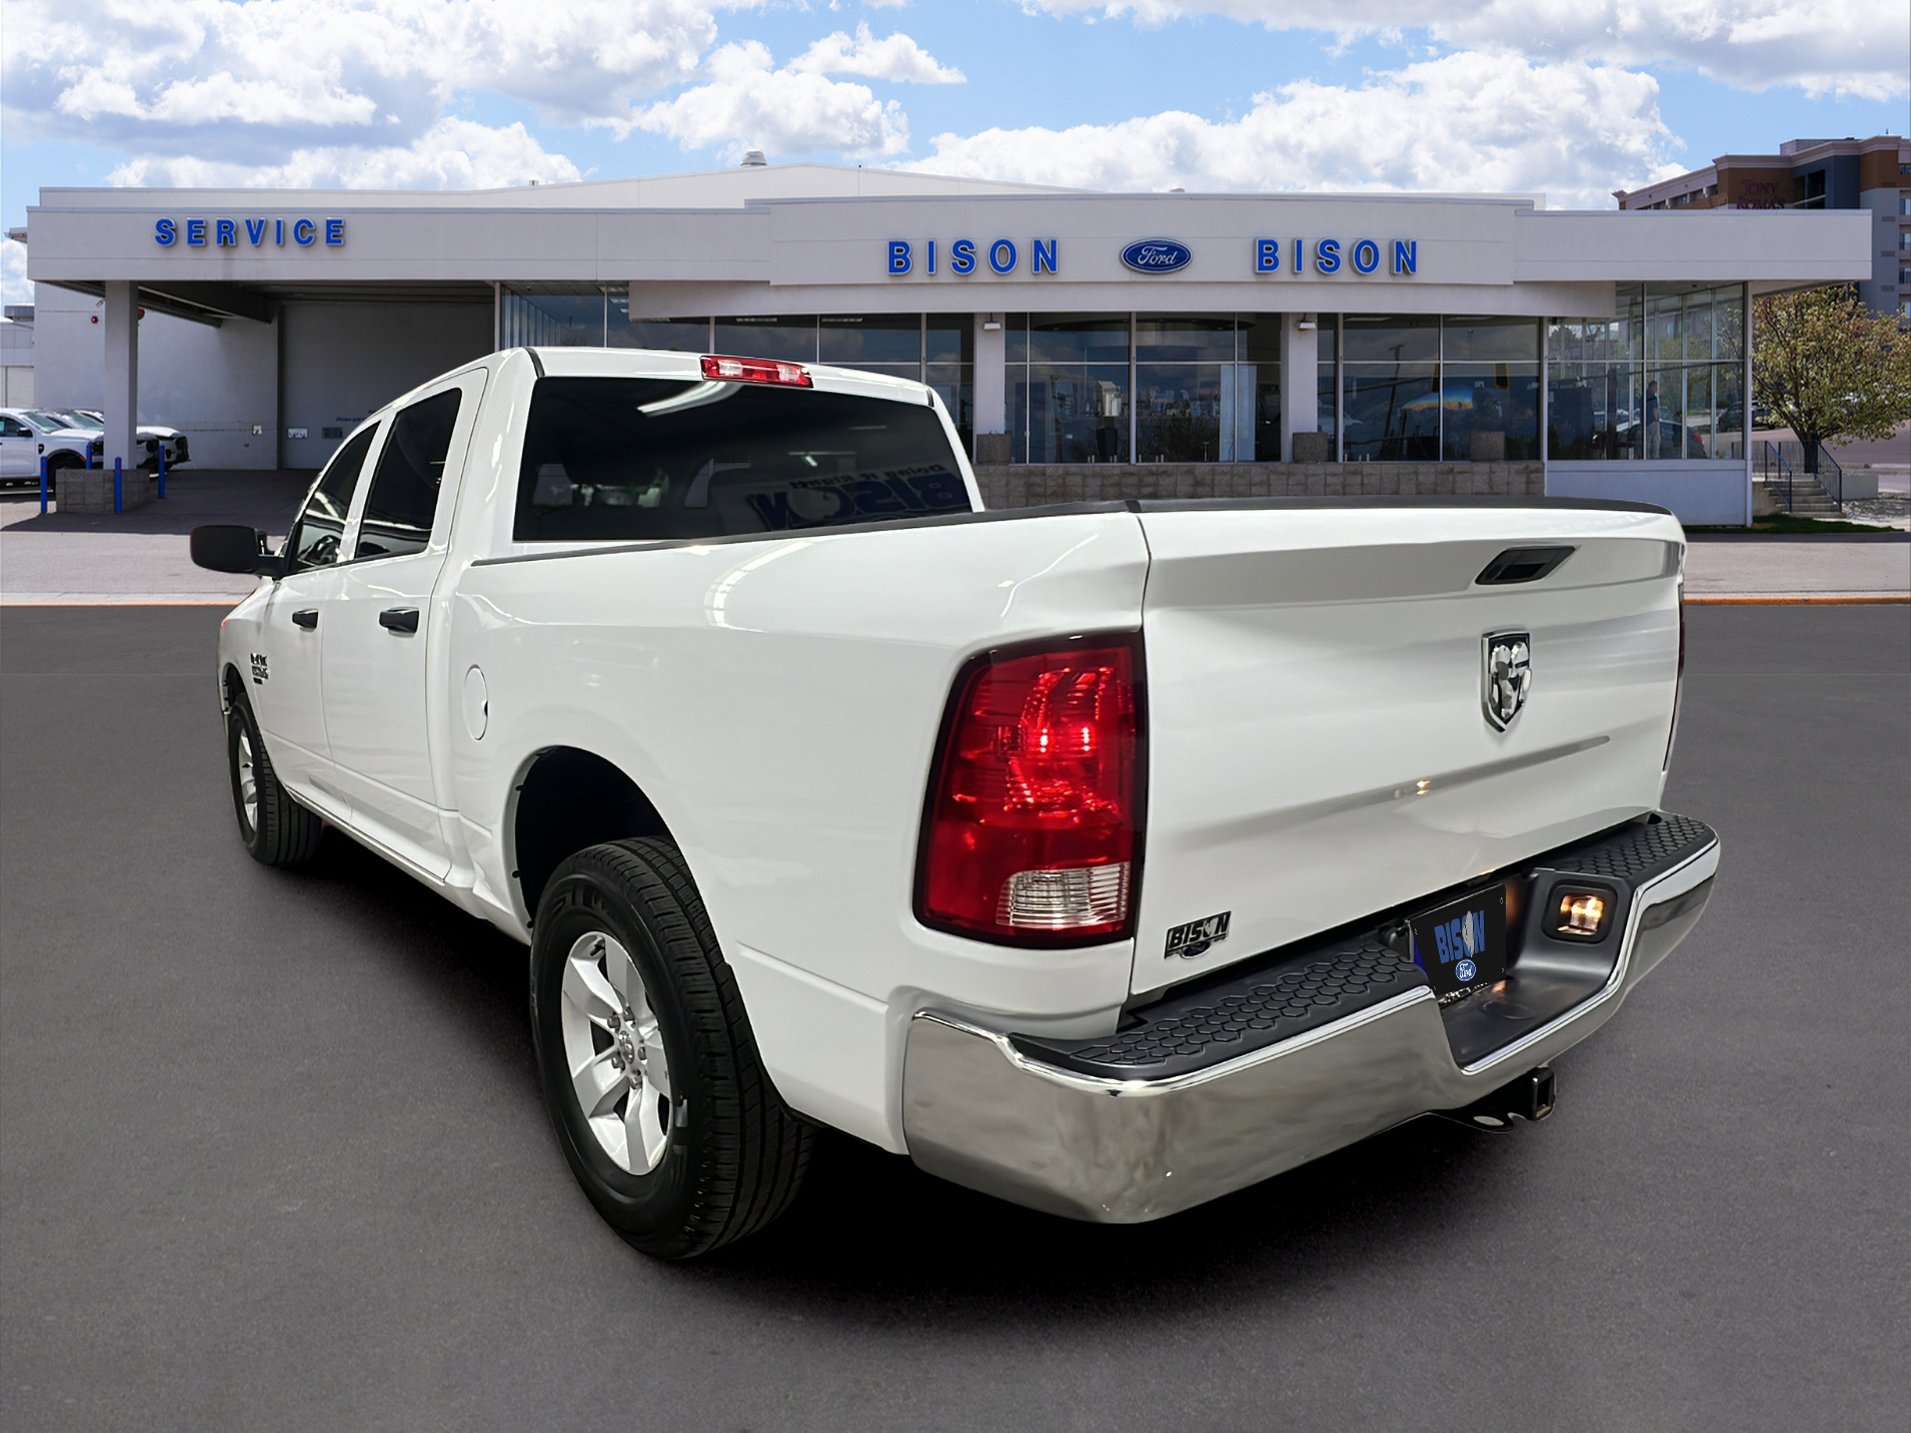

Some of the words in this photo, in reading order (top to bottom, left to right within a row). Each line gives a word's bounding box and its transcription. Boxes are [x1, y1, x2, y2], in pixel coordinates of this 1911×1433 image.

[154, 217, 346, 247] SERVICE
[887, 239, 1059, 276] BISON
[1137, 245, 1178, 267] Ford
[1255, 238, 1418, 275] BISON
